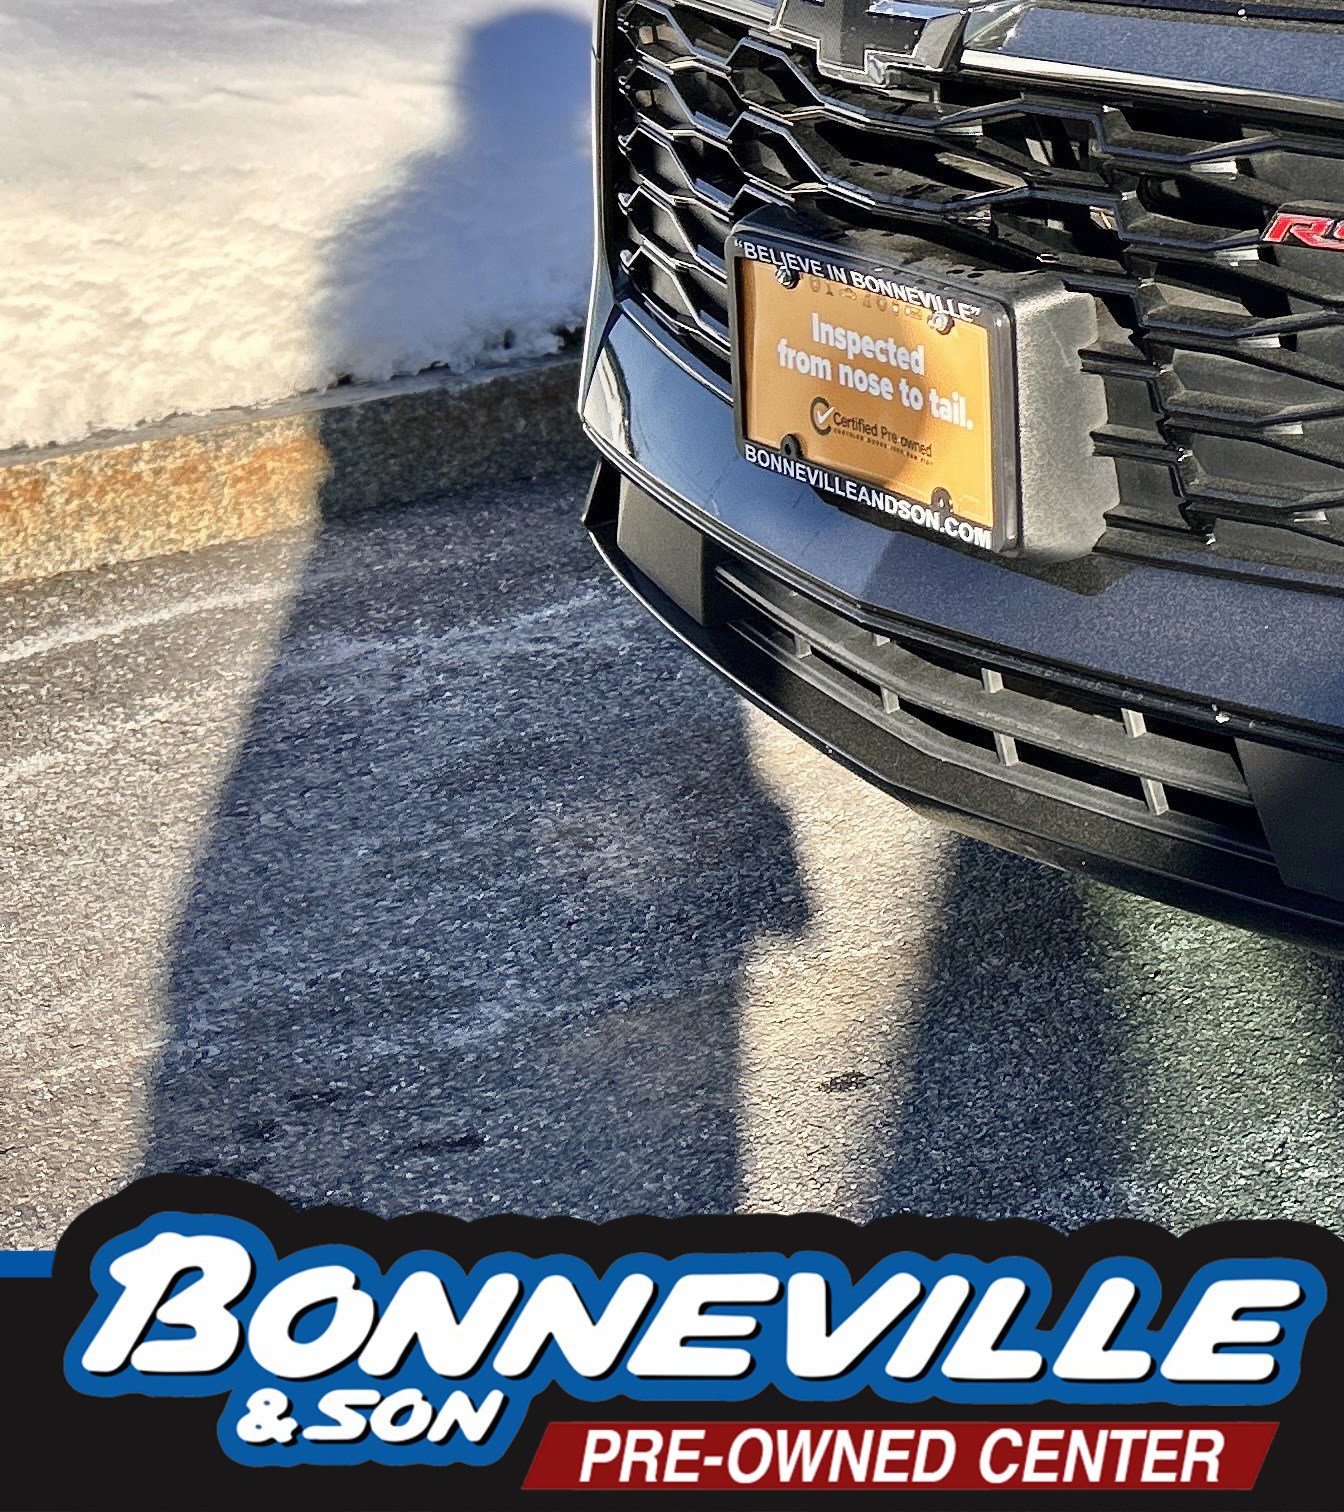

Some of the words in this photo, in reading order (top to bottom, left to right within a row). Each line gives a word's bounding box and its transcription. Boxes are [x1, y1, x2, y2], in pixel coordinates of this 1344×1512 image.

[827, 263, 848, 285] IN
[811, 312, 926, 376] Inspected
[777, 338, 832, 381] from
[838, 362, 894, 401] nose
[899, 377, 924, 411] to
[928, 387, 974, 430] tail.
[833, 411, 878, 437] Certified
[880, 426, 933, 457] Pre-owned
[744, 444, 992, 550] BONNEVILLEANDSON.COM
